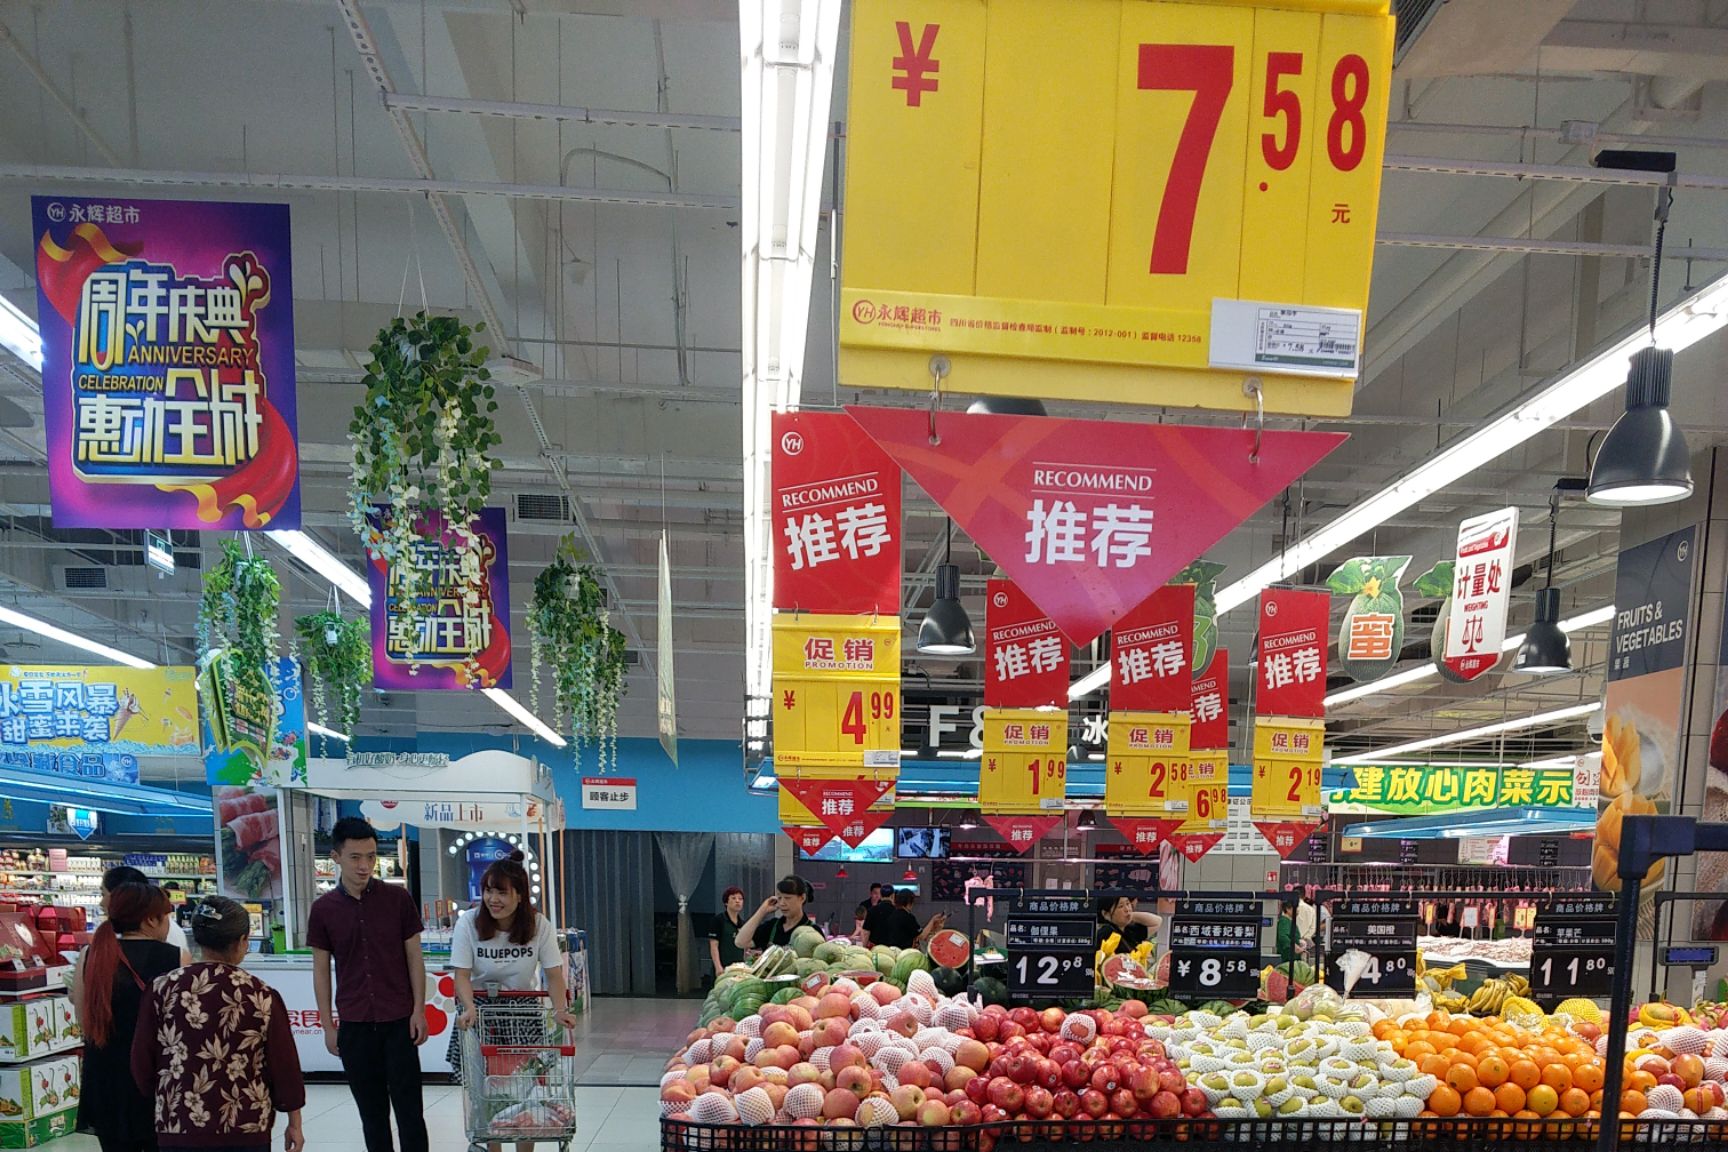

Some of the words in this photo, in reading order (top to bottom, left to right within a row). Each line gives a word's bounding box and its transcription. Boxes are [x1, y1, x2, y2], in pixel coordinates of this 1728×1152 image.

[69, 204, 140, 224] 永辉超市
[1331, 203, 1351, 223] 元
[79, 268, 249, 371] 周年庆典
[877, 304, 942, 325] 永辉超市
[128, 345, 253, 366] ANNIVERSARY
[78, 375, 164, 391] CELEBRATION
[78, 367, 263, 465] 惠动全城
[1033, 469, 1152, 492] RECOMMEND
[783, 478, 878, 507] RECOMMEND
[784, 502, 891, 570] 推荐
[1025, 499, 1154, 568] 推荐
[1457, 558, 1502, 599] 计量处
[1617, 604, 1653, 631] FRUITS
[1654, 601, 1662, 620] &
[992, 620, 1056, 641] RECOMMEND
[1117, 625, 1178, 645] RECOMMEND
[1264, 631, 1316, 650] RECOMMEND
[1348, 612, 1395, 660] 蜜
[1616, 619, 1683, 654] VEGETABLES
[804, 638, 873, 662] 促销
[994, 636, 1064, 681] 推荐
[804, 660, 873, 669] PROMOTION
[1118, 640, 1186, 685] 推荐
[1264, 647, 1321, 689] 推荐
[1004, 724, 1049, 740] 促销
[1082, 715, 1109, 744] 冰
[1129, 728, 1174, 744] 促销
[1272, 733, 1309, 748] 促销
[589, 791, 630, 801] 顾客止步
[424, 802, 484, 822] 新品上市
[822, 799, 854, 815] 推荐
[843, 825, 865, 837] 推荐
[1011, 829, 1033, 841] 推荐
[1136, 831, 1157, 843] 推荐
[1276, 835, 1294, 846] 推荐
[1029, 901, 1079, 911] 商品价格牌
[1194, 903, 1244, 912] 商品价格牌
[1351, 903, 1400, 912] 商品价格牌
[1556, 903, 1604, 912] 商品价格牌
[1189, 925, 1255, 937] 西域香妃香梨
[477, 946, 534, 959] BLUEPOPS
